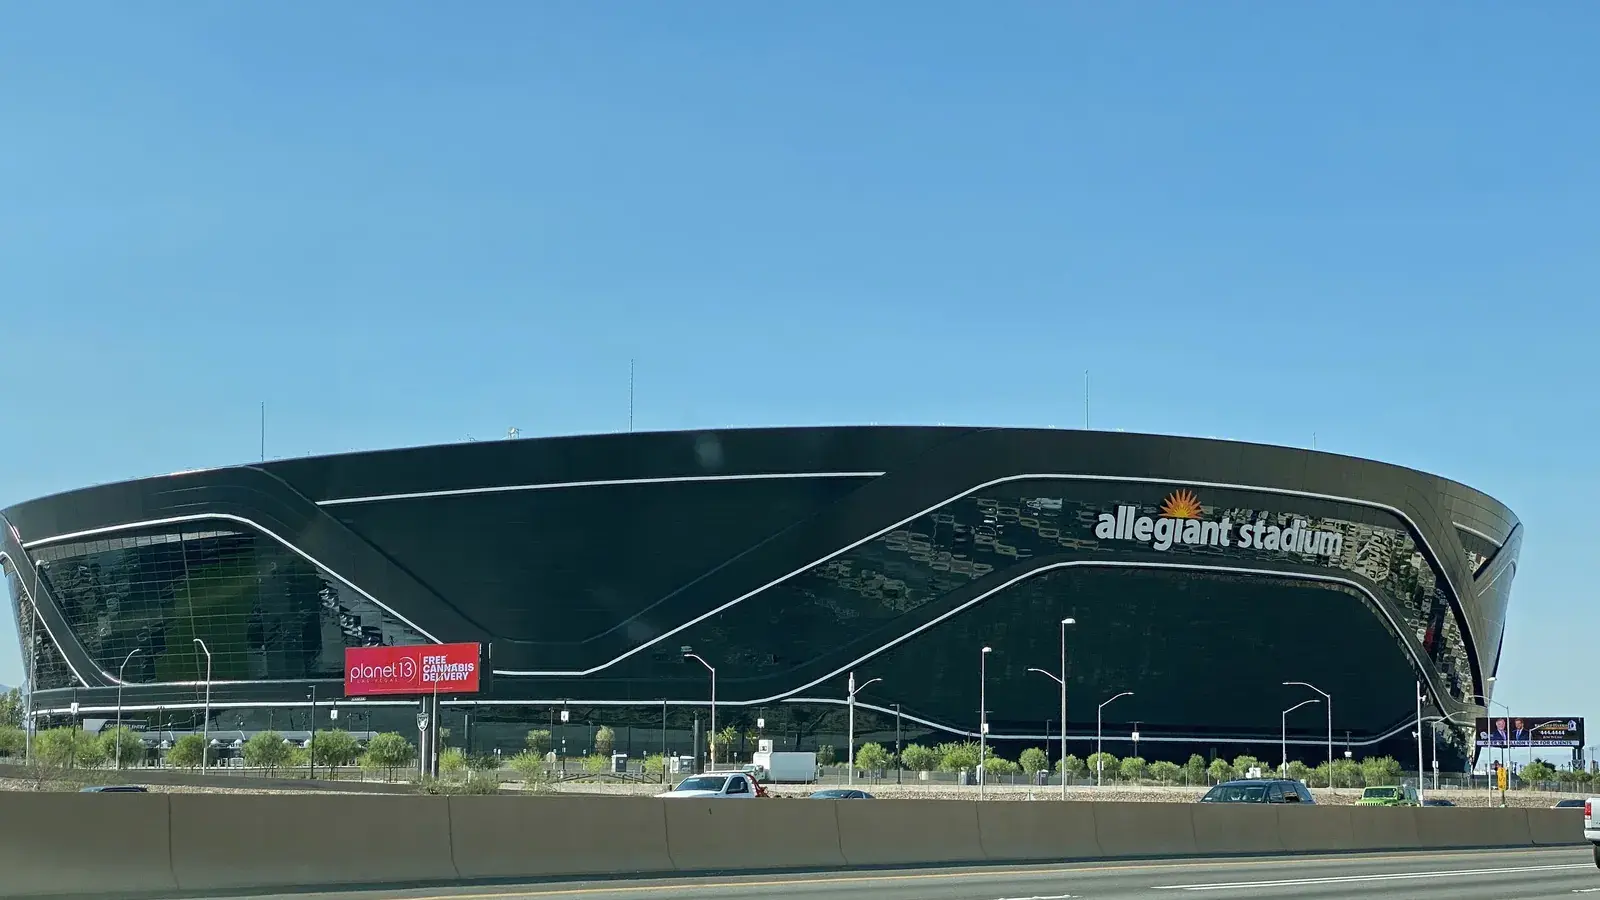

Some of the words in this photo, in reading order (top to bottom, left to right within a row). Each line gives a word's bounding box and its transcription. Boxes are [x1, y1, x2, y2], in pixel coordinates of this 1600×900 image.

[1095, 505, 1231, 550] allegiant
[1238, 519, 1343, 556] stadium
[423, 655, 447, 664] FREE
[350, 662, 397, 683] planet
[399, 661, 413, 678] 13
[423, 663, 474, 673] CANNABIS
[423, 672, 468, 681] DELIVERY
